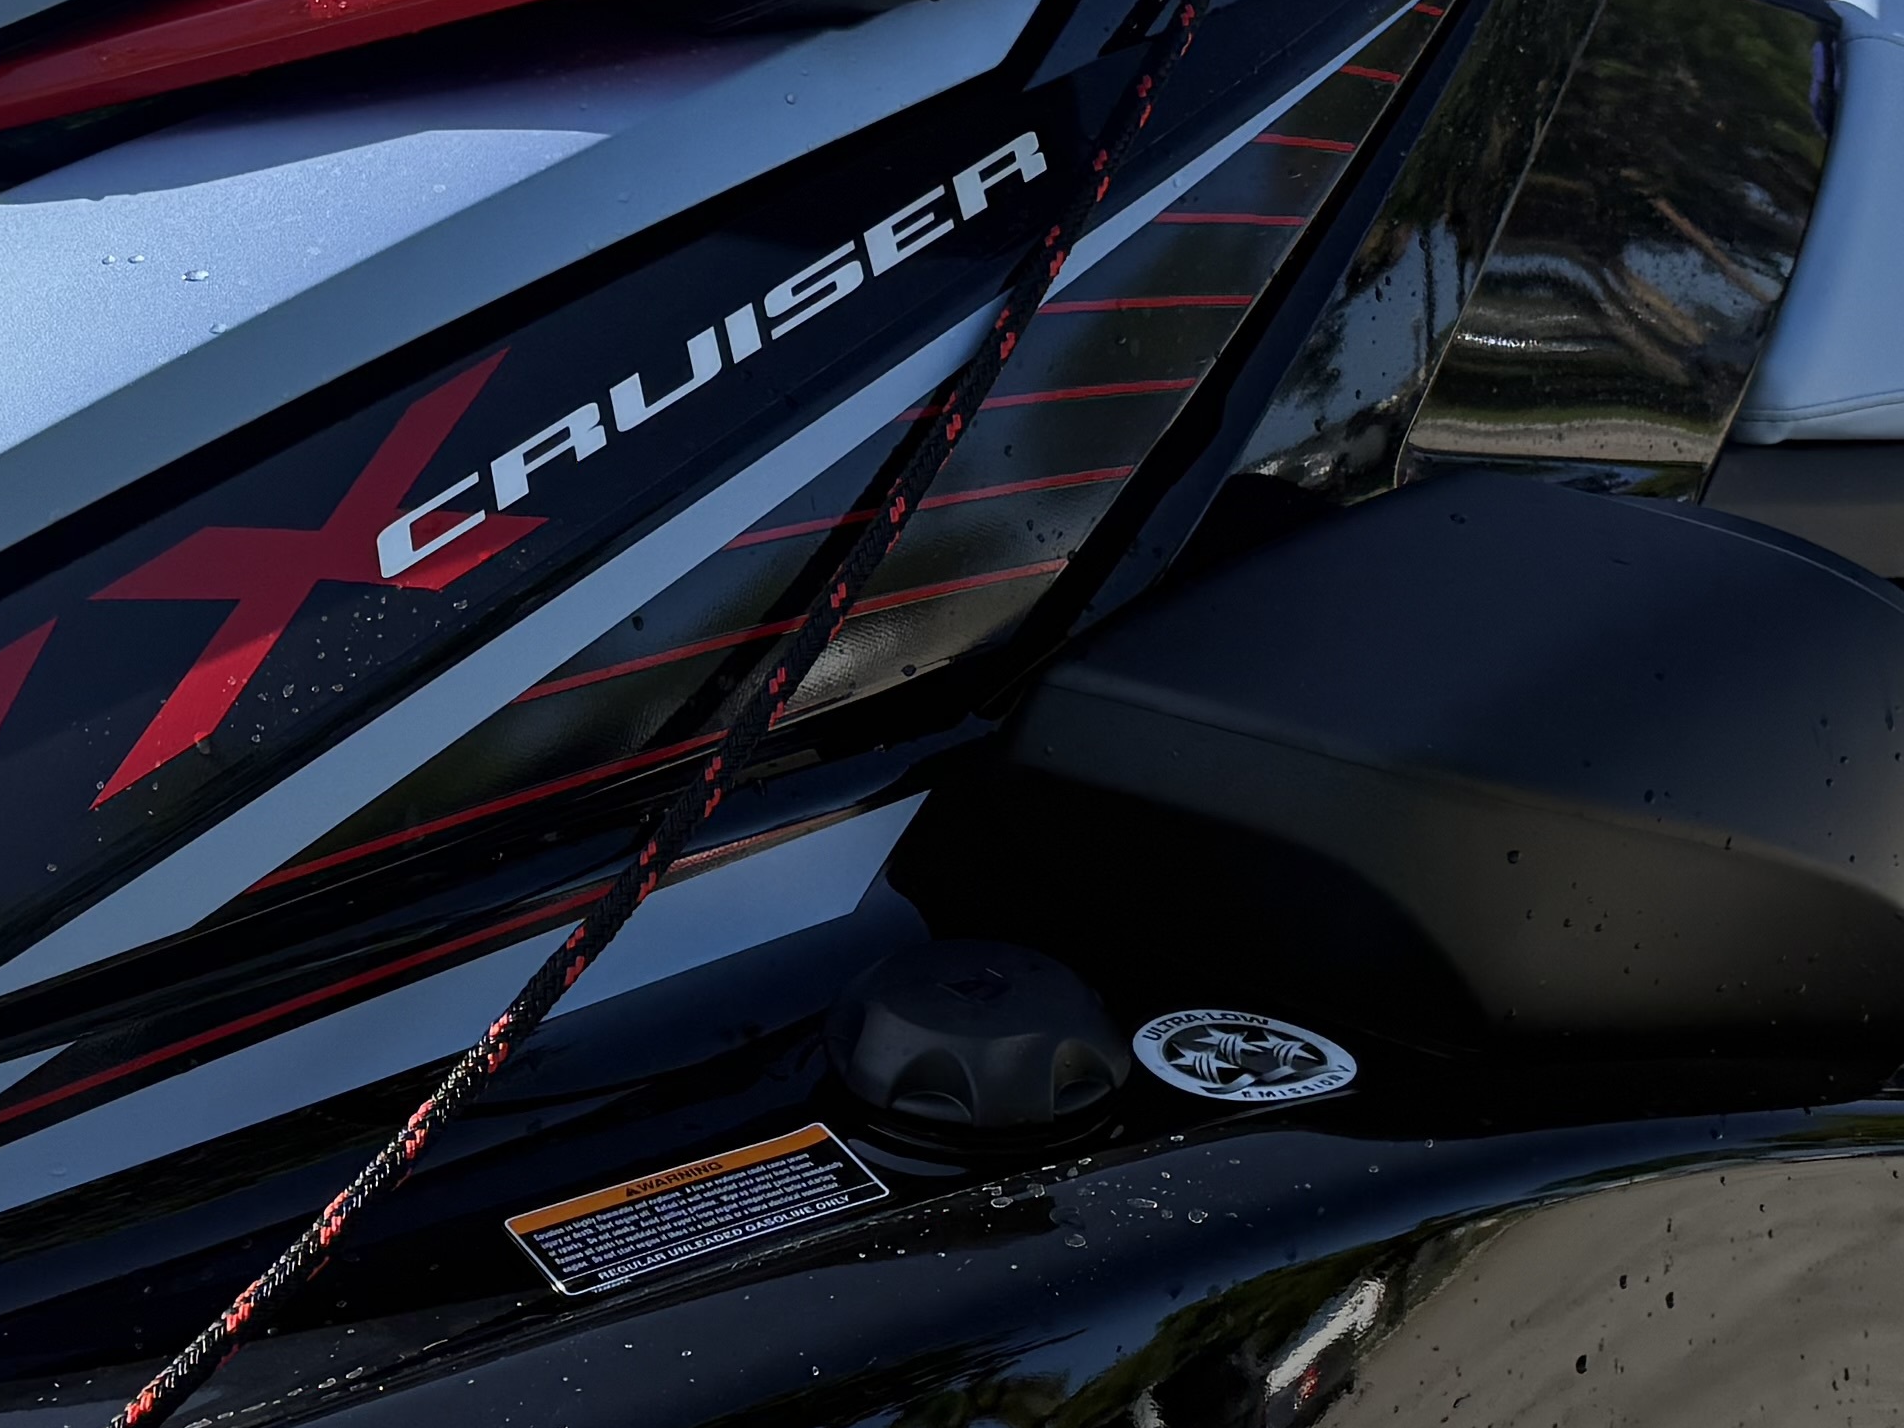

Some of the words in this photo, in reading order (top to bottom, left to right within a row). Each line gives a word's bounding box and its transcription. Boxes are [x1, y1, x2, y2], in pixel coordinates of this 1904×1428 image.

[376, 130, 1049, 578] CRUISER
[636, 1162, 723, 1191] WARNING
[598, 1253, 666, 1280] REGULAR
[667, 1229, 743, 1257] UNLEADED
[745, 1206, 815, 1231] GASOLINE
[816, 1195, 849, 1210] ONLY
